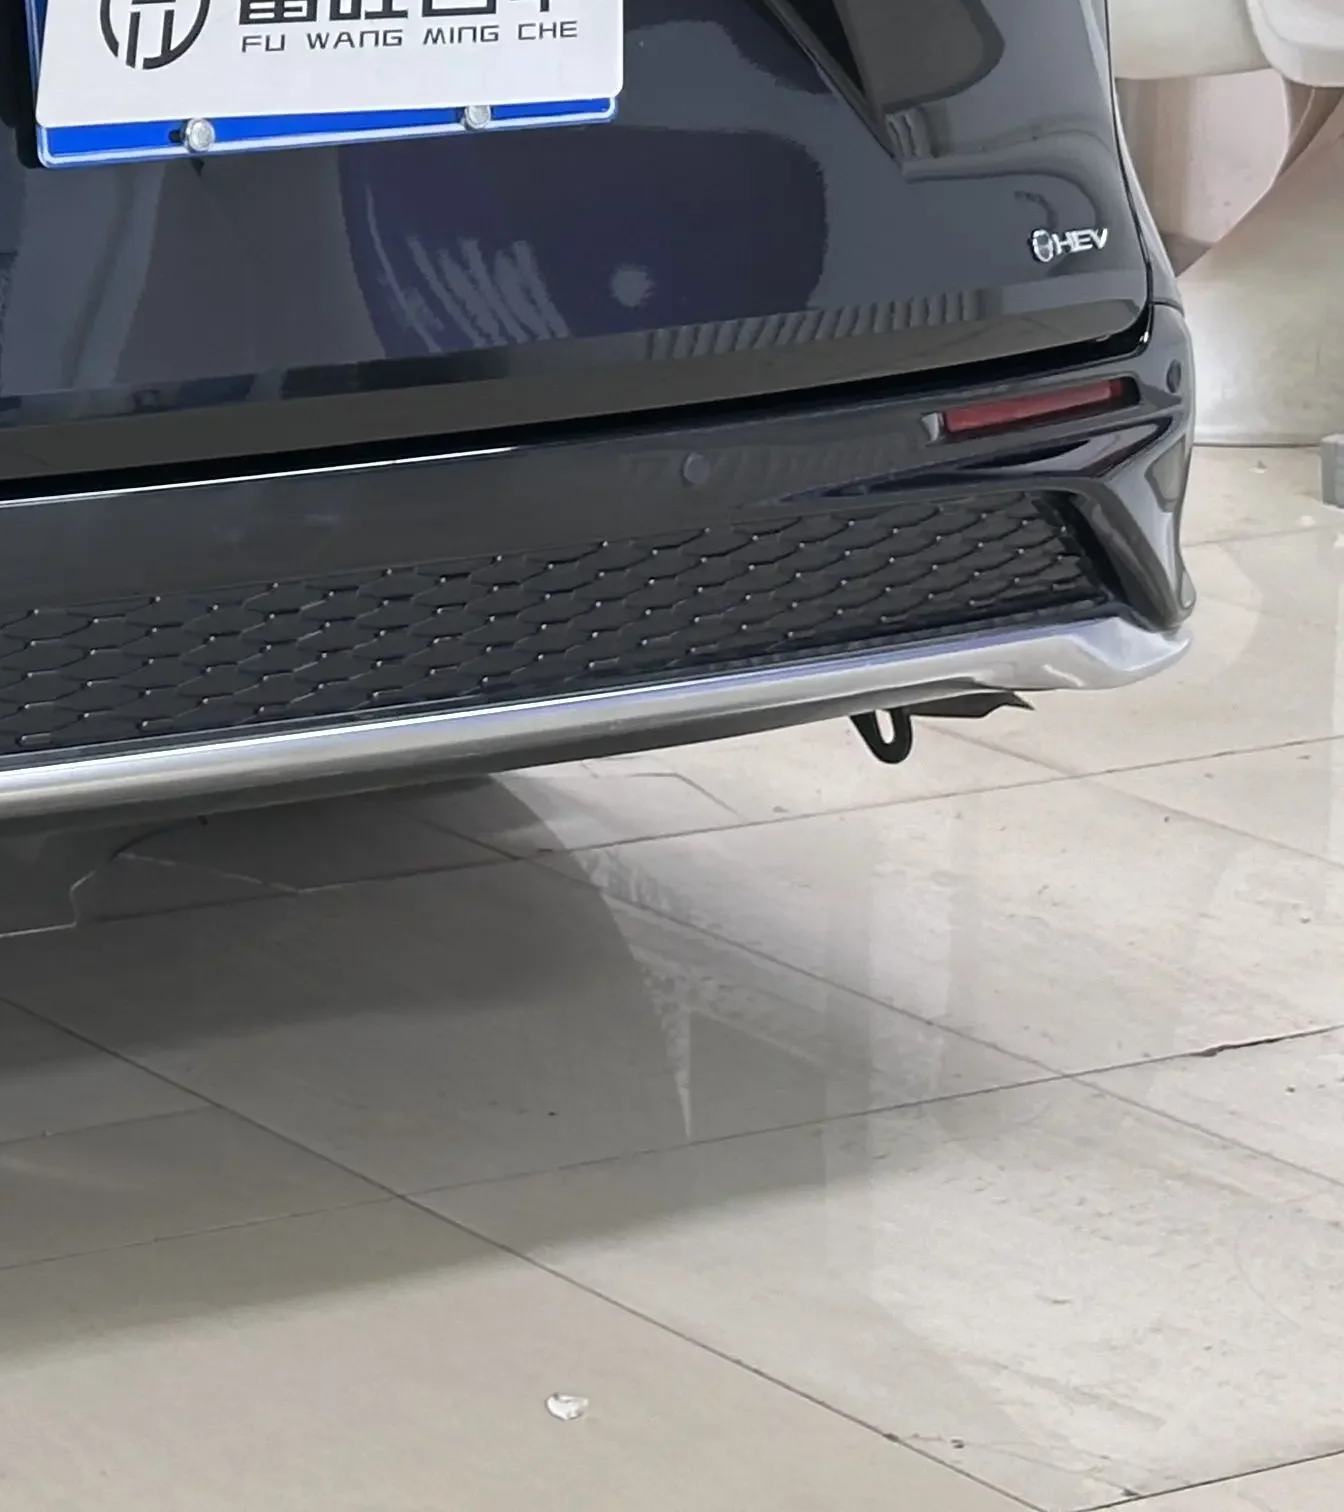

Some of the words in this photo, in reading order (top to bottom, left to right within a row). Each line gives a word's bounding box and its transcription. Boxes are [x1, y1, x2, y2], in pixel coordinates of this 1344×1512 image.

[241, 34, 286, 53] FU
[307, 29, 404, 49] WANG
[423, 25, 500, 45] MING
[517, 20, 579, 40] CHE
[1052, 228, 1108, 255] HEV
